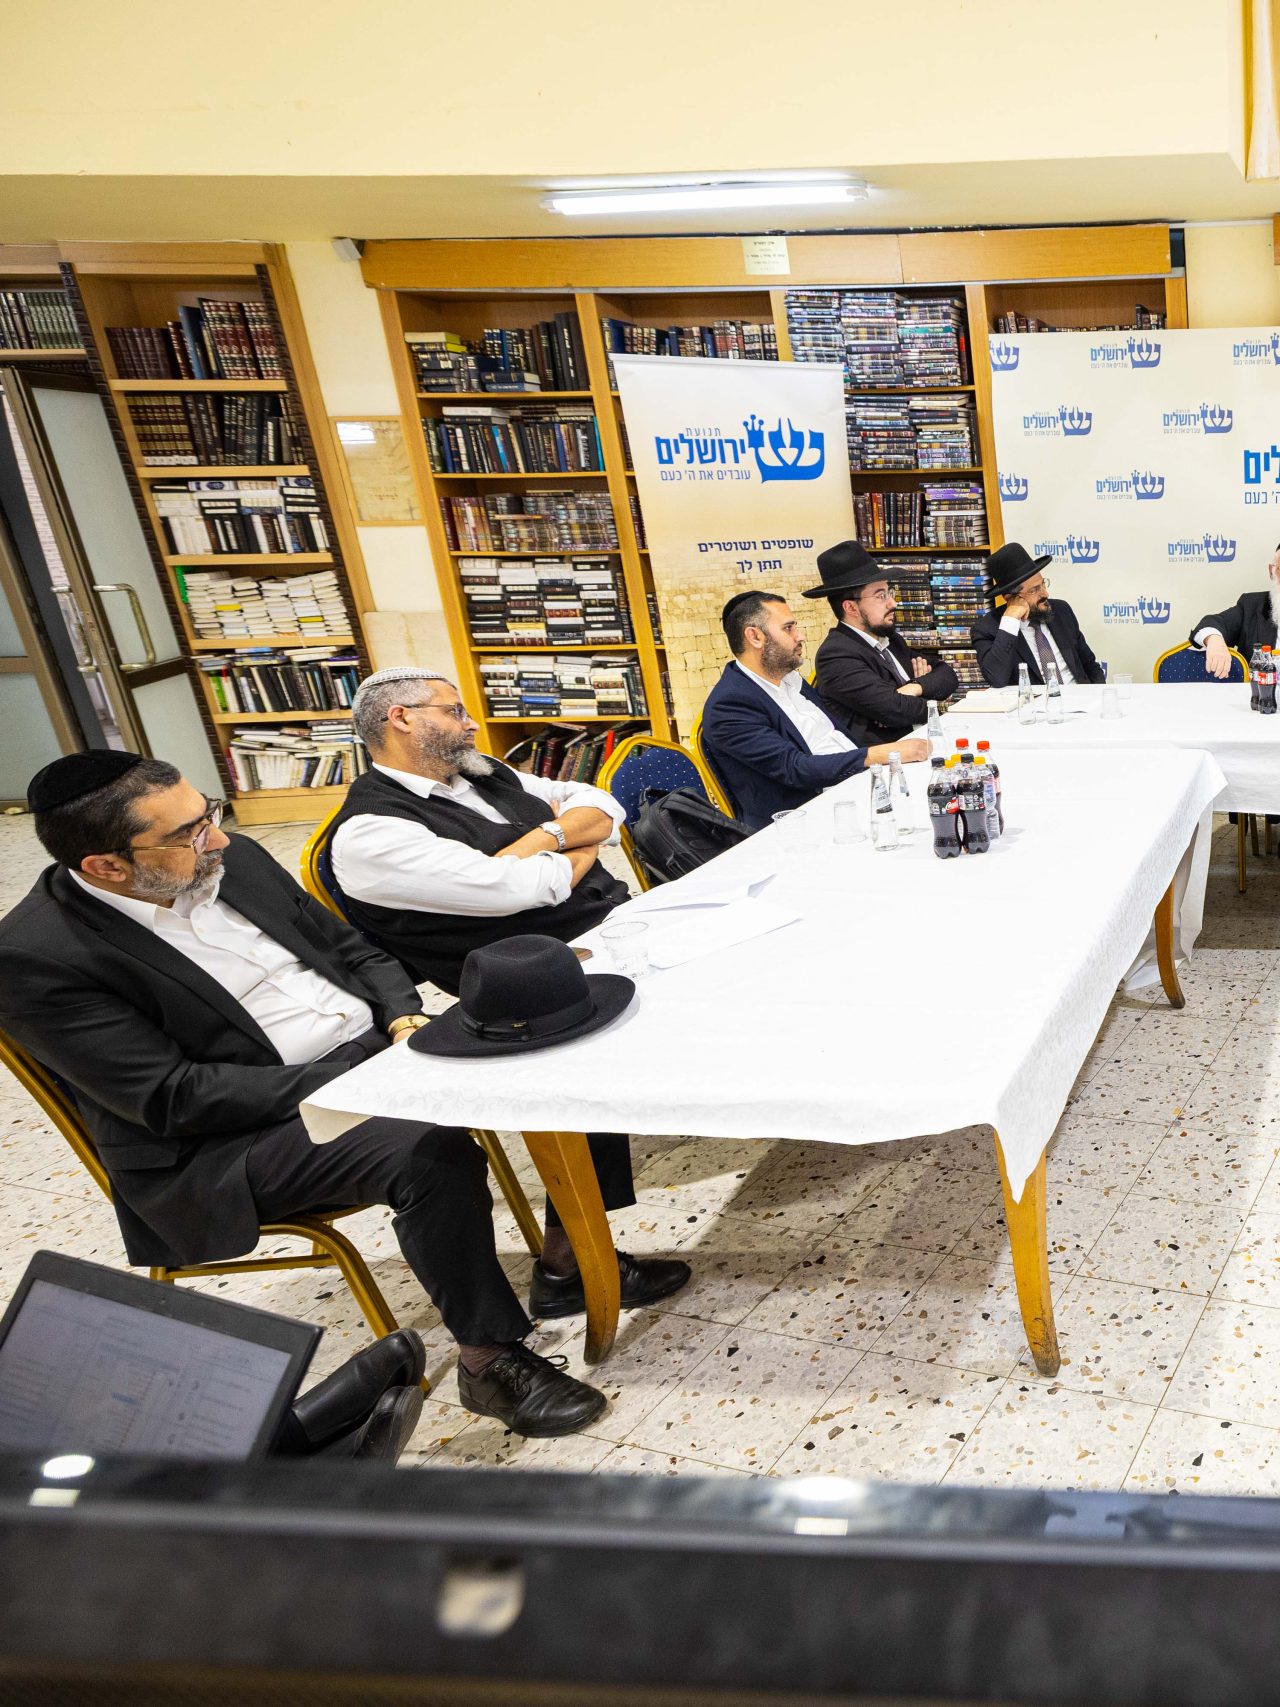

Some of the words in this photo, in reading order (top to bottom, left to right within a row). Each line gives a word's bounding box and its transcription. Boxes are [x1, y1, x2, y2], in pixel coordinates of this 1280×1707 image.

[1090, 346, 1127, 361] ירושלים
[1233, 342, 1270, 357] ירושלים
[1024, 414, 1059, 428] ירושלים
[1163, 412, 1199, 426] ירושלים
[686, 427, 721, 437] תנועת
[654, 433, 746, 464] ירושלים
[661, 471, 682, 481] כעם
[685, 471, 695, 481] ה'
[700, 470, 713, 480] את
[717, 469, 750, 480] עובדים
[1096, 479, 1131, 492] ירושלים
[1244, 492, 1267, 505] כעם
[697, 541, 757, 552] ושוטרים
[762, 538, 813, 550] שופטים
[1168, 542, 1203, 555] ירושלים
[736, 560, 753, 573] לך
[758, 559, 782, 573] תתן
[1104, 604, 1138, 617] ירושלים
